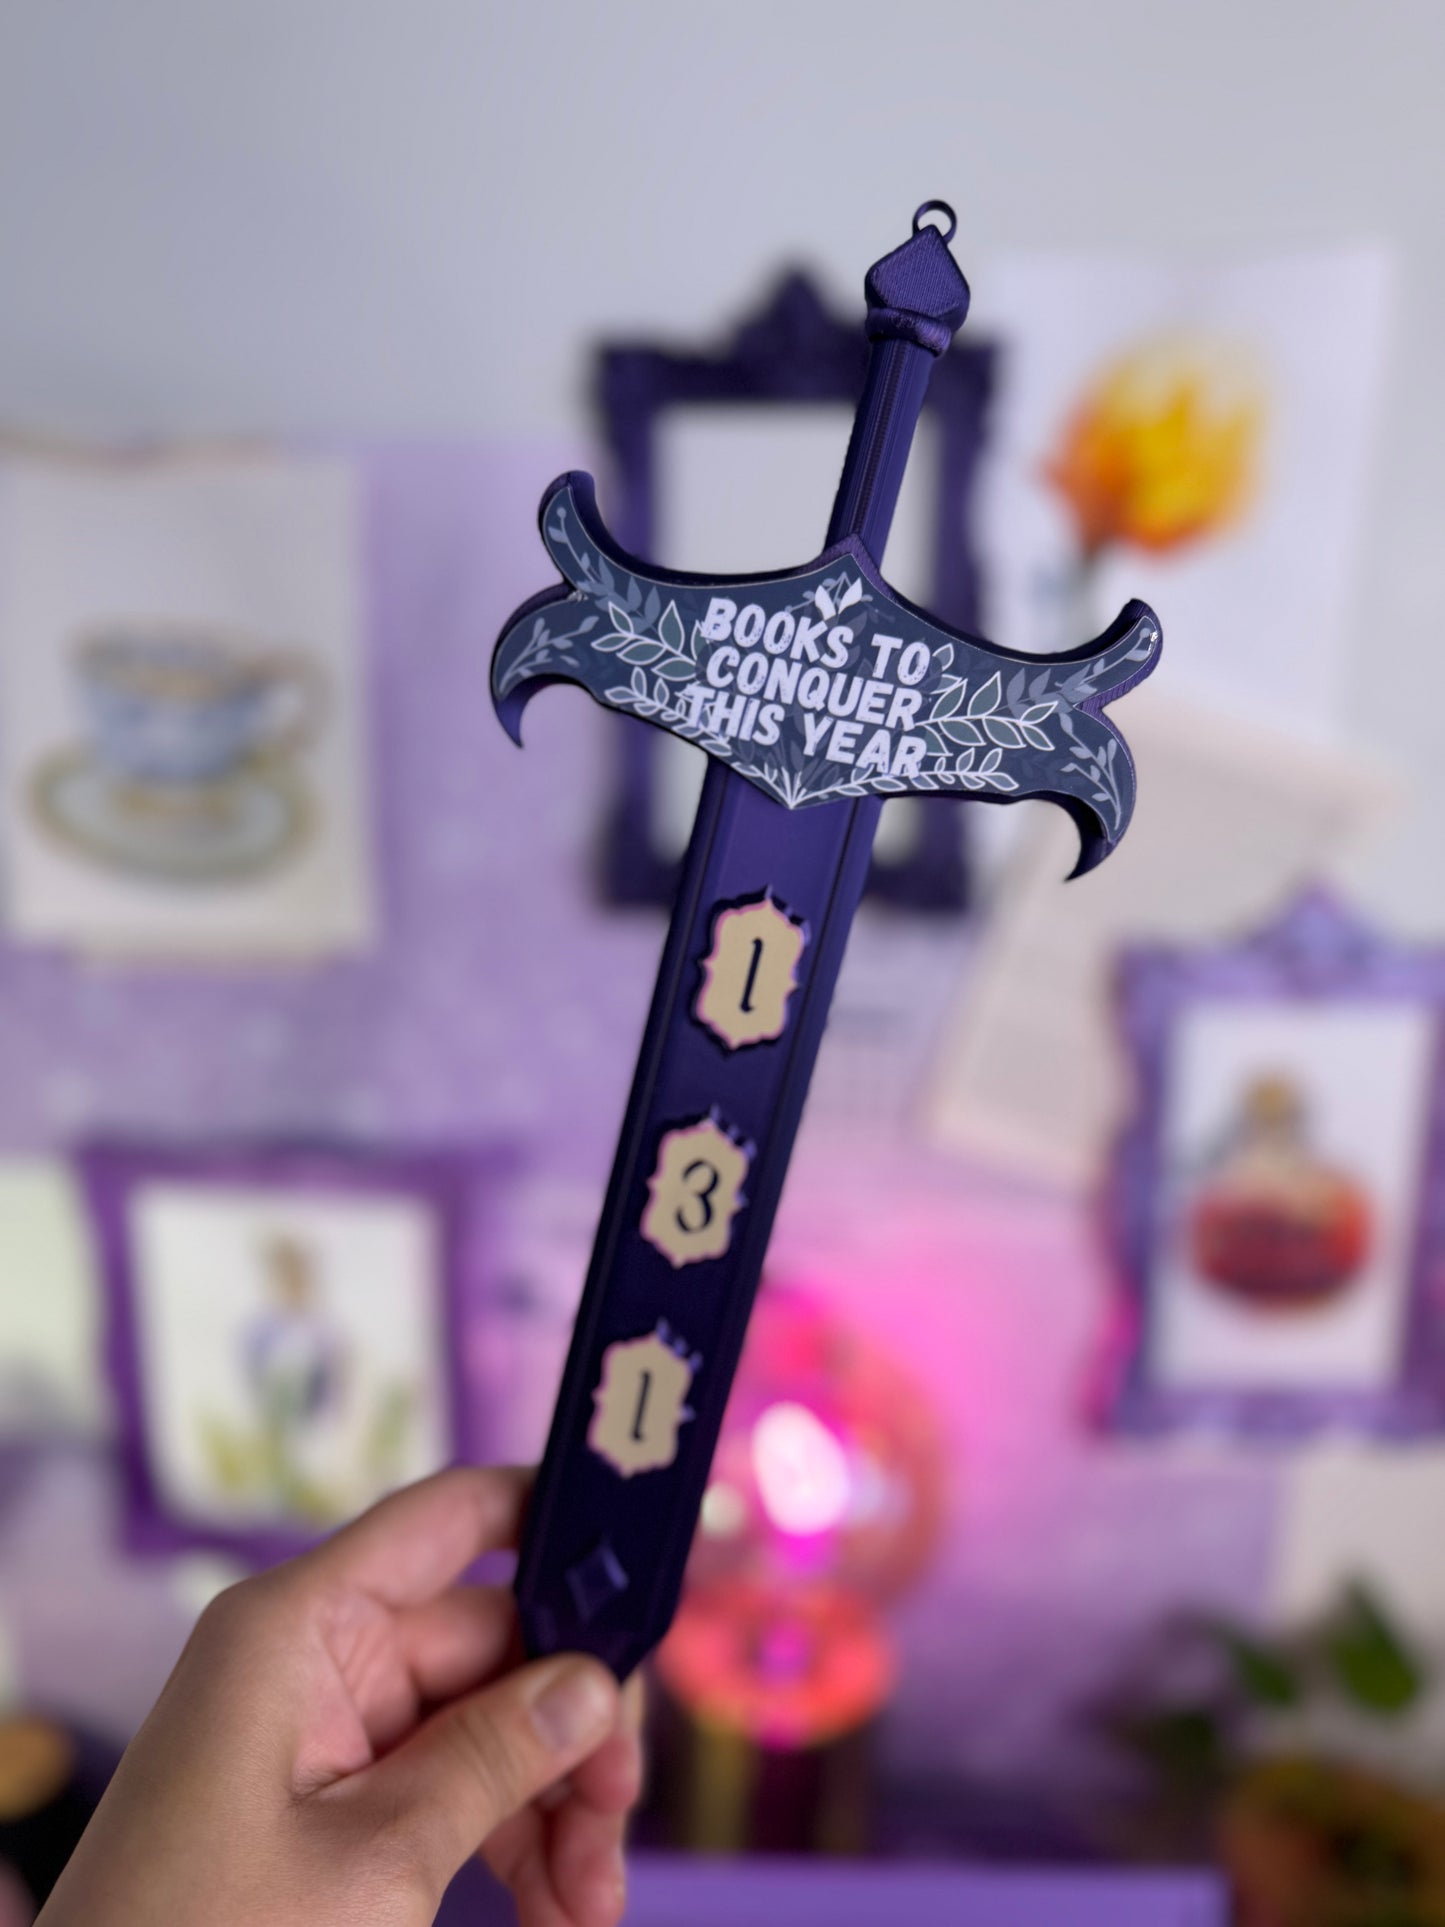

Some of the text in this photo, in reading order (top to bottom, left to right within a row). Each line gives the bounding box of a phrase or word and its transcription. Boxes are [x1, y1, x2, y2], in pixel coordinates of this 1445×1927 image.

[700, 597, 931, 686] BOOKS TO
[706, 646, 923, 732] CONQUER
[682, 683, 927, 779] THIS YEAR
[739, 936, 764, 1013] 1
[675, 1159, 721, 1234] 3
[630, 1368, 653, 1443] 1
